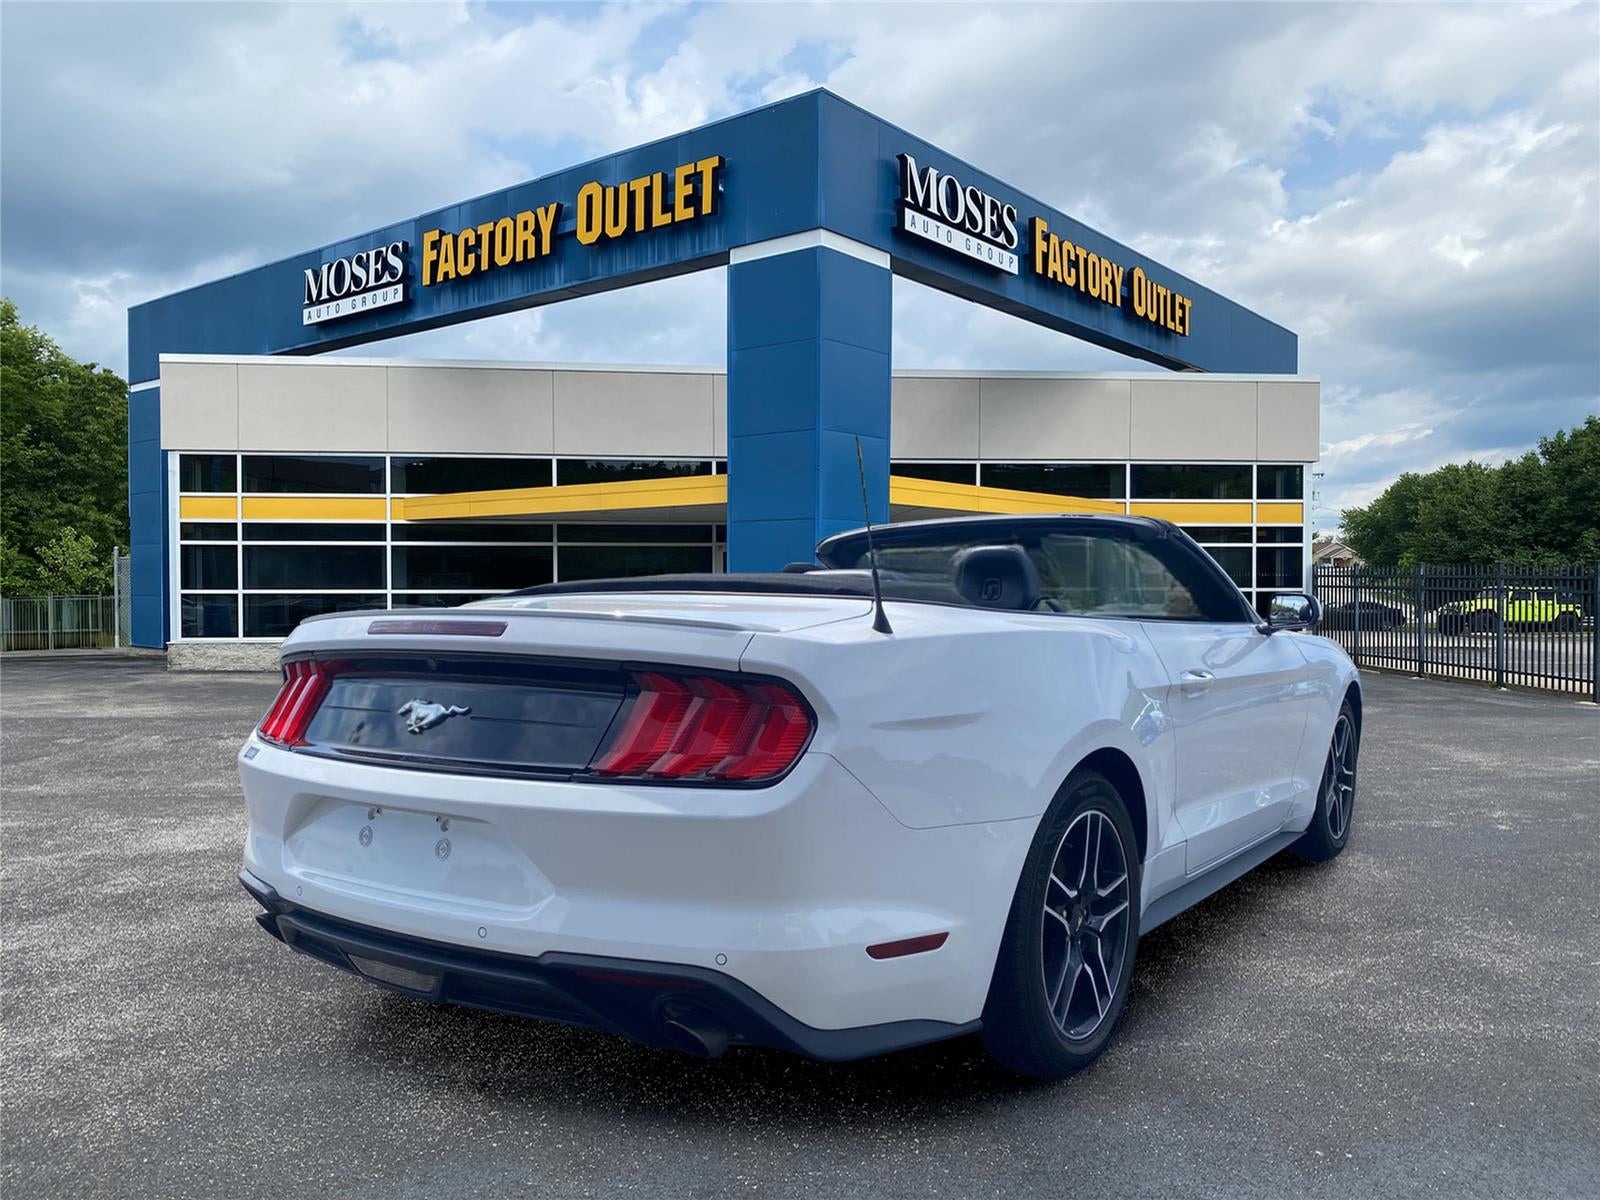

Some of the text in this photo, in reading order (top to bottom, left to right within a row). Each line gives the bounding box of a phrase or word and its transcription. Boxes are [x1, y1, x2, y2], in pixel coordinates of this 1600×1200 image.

[422, 155, 720, 286] FACTORY OUTLET
[904, 153, 1018, 249] MOSES
[304, 241, 404, 305] MOSES
[910, 215, 1014, 268] AUTO GROUP
[1035, 216, 1192, 336] FACTORY OUTLET
[307, 289, 399, 321] AUTO GROUP
